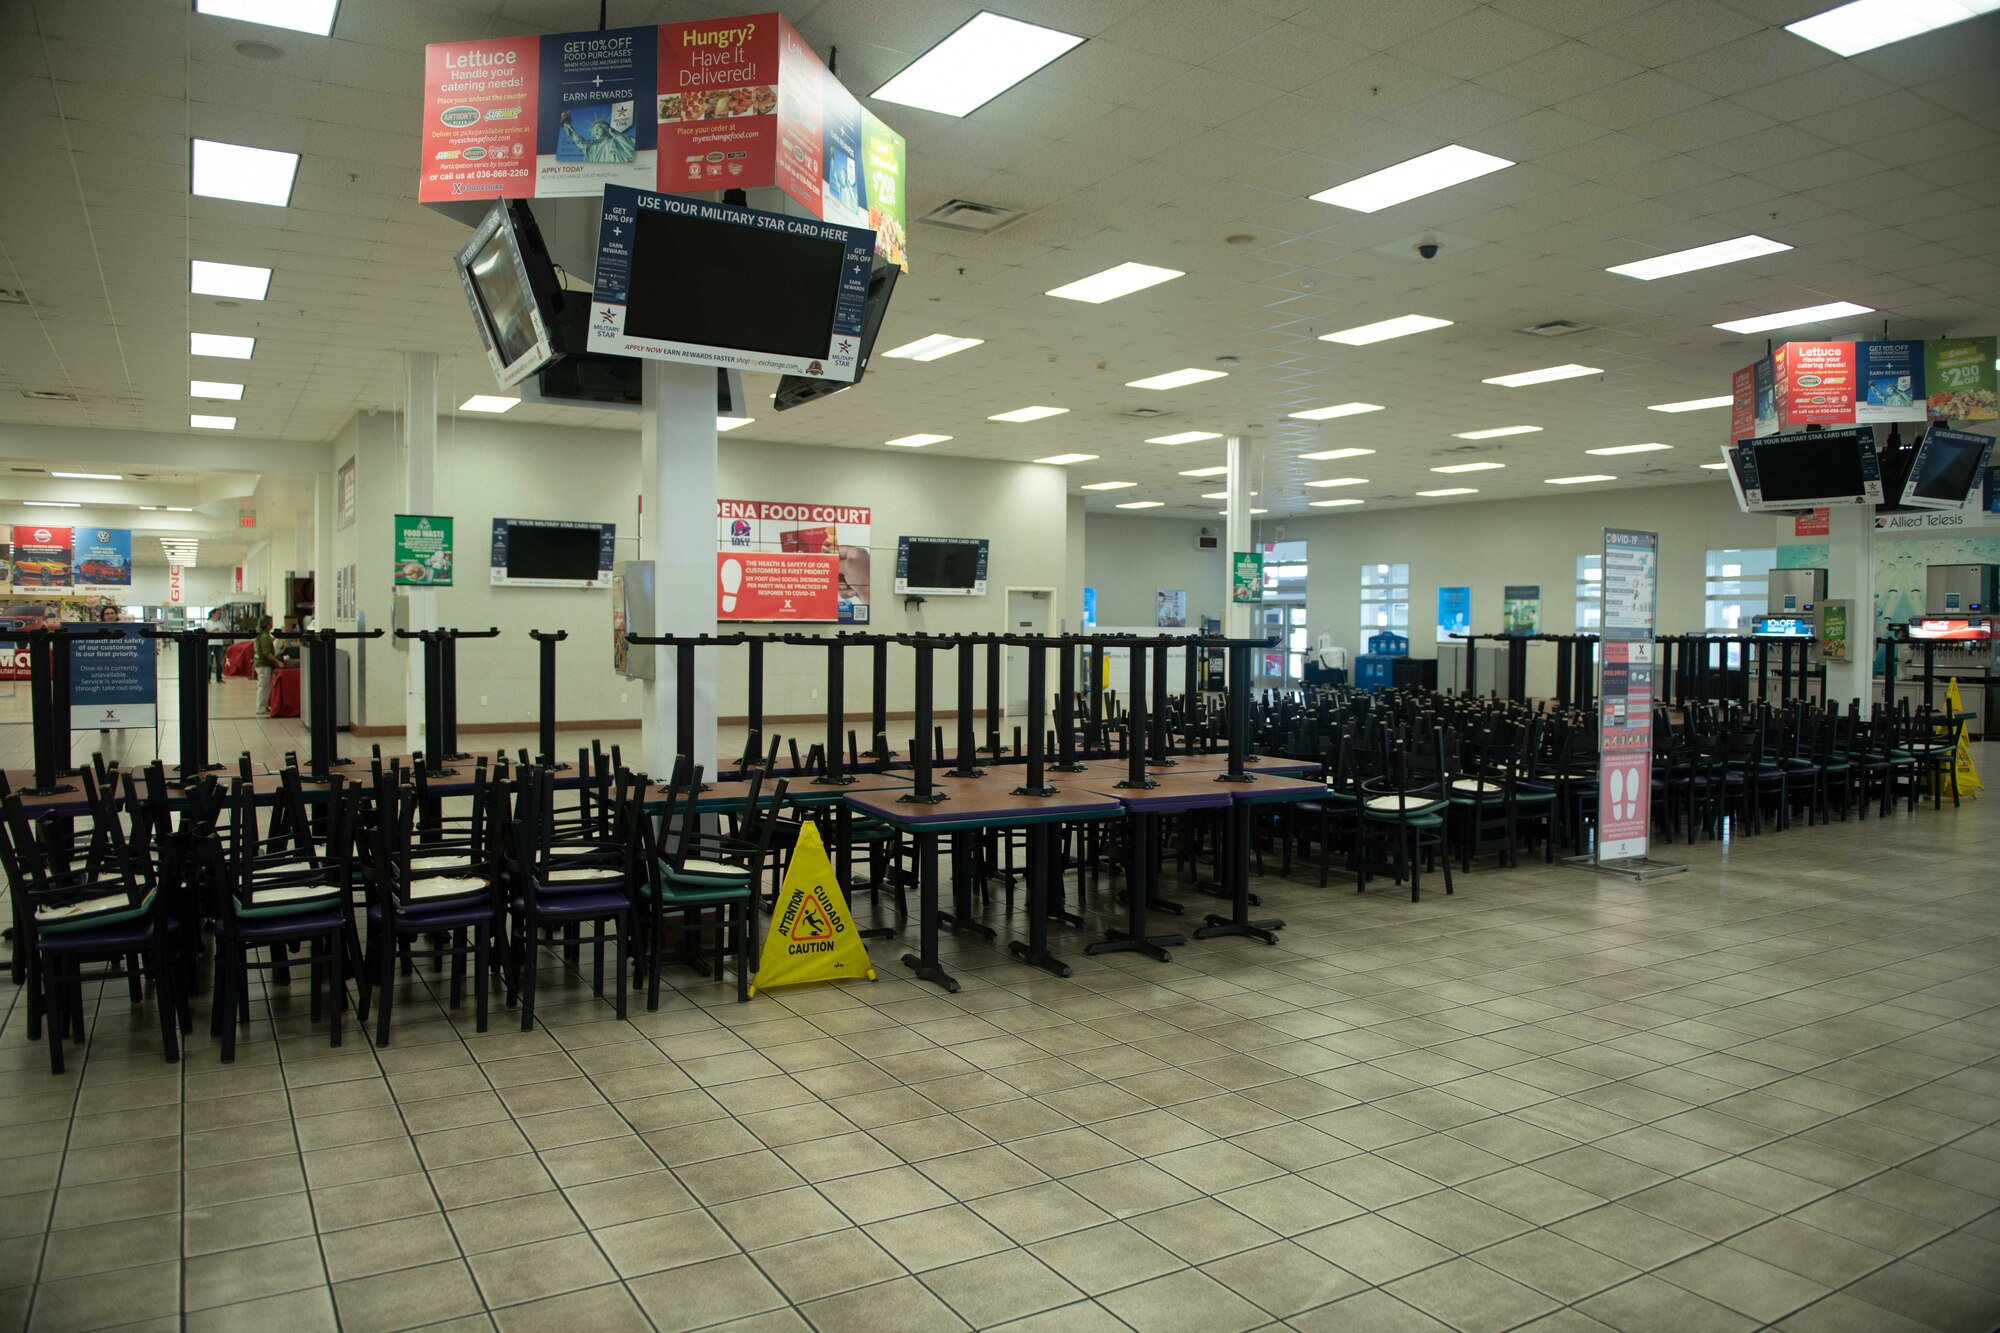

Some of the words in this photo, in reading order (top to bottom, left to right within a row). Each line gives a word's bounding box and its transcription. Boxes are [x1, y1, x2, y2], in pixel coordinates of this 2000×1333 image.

[683, 24, 755, 48] Hungry?
[564, 42, 586, 53] GET
[588, 40, 607, 51] 10%
[608, 37, 632, 49] OFF
[446, 51, 516, 68] Lettuce
[693, 50, 729, 67] Have
[735, 48, 744, 63] It
[451, 68, 488, 80] Handle
[491, 68, 515, 79] your
[680, 63, 756, 86] Delivered!
[441, 81, 485, 92] catering
[488, 77, 524, 88] needs!
[563, 92, 587, 101] EARN
[590, 89, 632, 100] REWARDS
[677, 127, 693, 135] Place
[695, 127, 709, 136] your
[693, 131, 759, 144] myexchangefood.com
[449, 136, 510, 145] myexchangefood.com
[440, 162, 473, 170] Participation
[440, 172, 453, 180] call
[477, 169, 528, 178] 036-868-2260
[613, 207, 627, 215] GET
[604, 213, 618, 222] 10%
[620, 215, 634, 224] OFF
[638, 195, 661, 209] USE
[664, 199, 698, 216] YOUR
[701, 204, 754, 226] MILITARY
[758, 216, 785, 232] STAR
[788, 220, 818, 236] CARD
[821, 226, 848, 242] HERE
[603, 247, 628, 256] REWARDS
[847, 253, 859, 261] 10%
[860, 255, 871, 263] OFF
[844, 284, 865, 292] REWARDS
[594, 324, 620, 333] MILITARY
[625, 344, 645, 352] APPLY
[645, 346, 663, 354] NOW
[663, 348, 681, 356] EARN
[682, 351, 712, 360] REWARDS
[714, 355, 735, 363] FASTER
[1799, 347, 1841, 356] Lettuce
[1964, 376, 1980, 384] OFF
[1781, 435, 1807, 444] MILITARY
[761, 505, 809, 521] FOOD
[812, 506, 868, 523] COURT
[1890, 517, 1922, 527] Allied
[1926, 514, 1963, 526] Telesis
[1606, 533, 1638, 545] COVID-19
[171, 565, 179, 602] GNC
[778, 888, 805, 937] ATTENTION
[813, 885, 845, 933] CUIDADO
[788, 941, 834, 955] CAUTION
